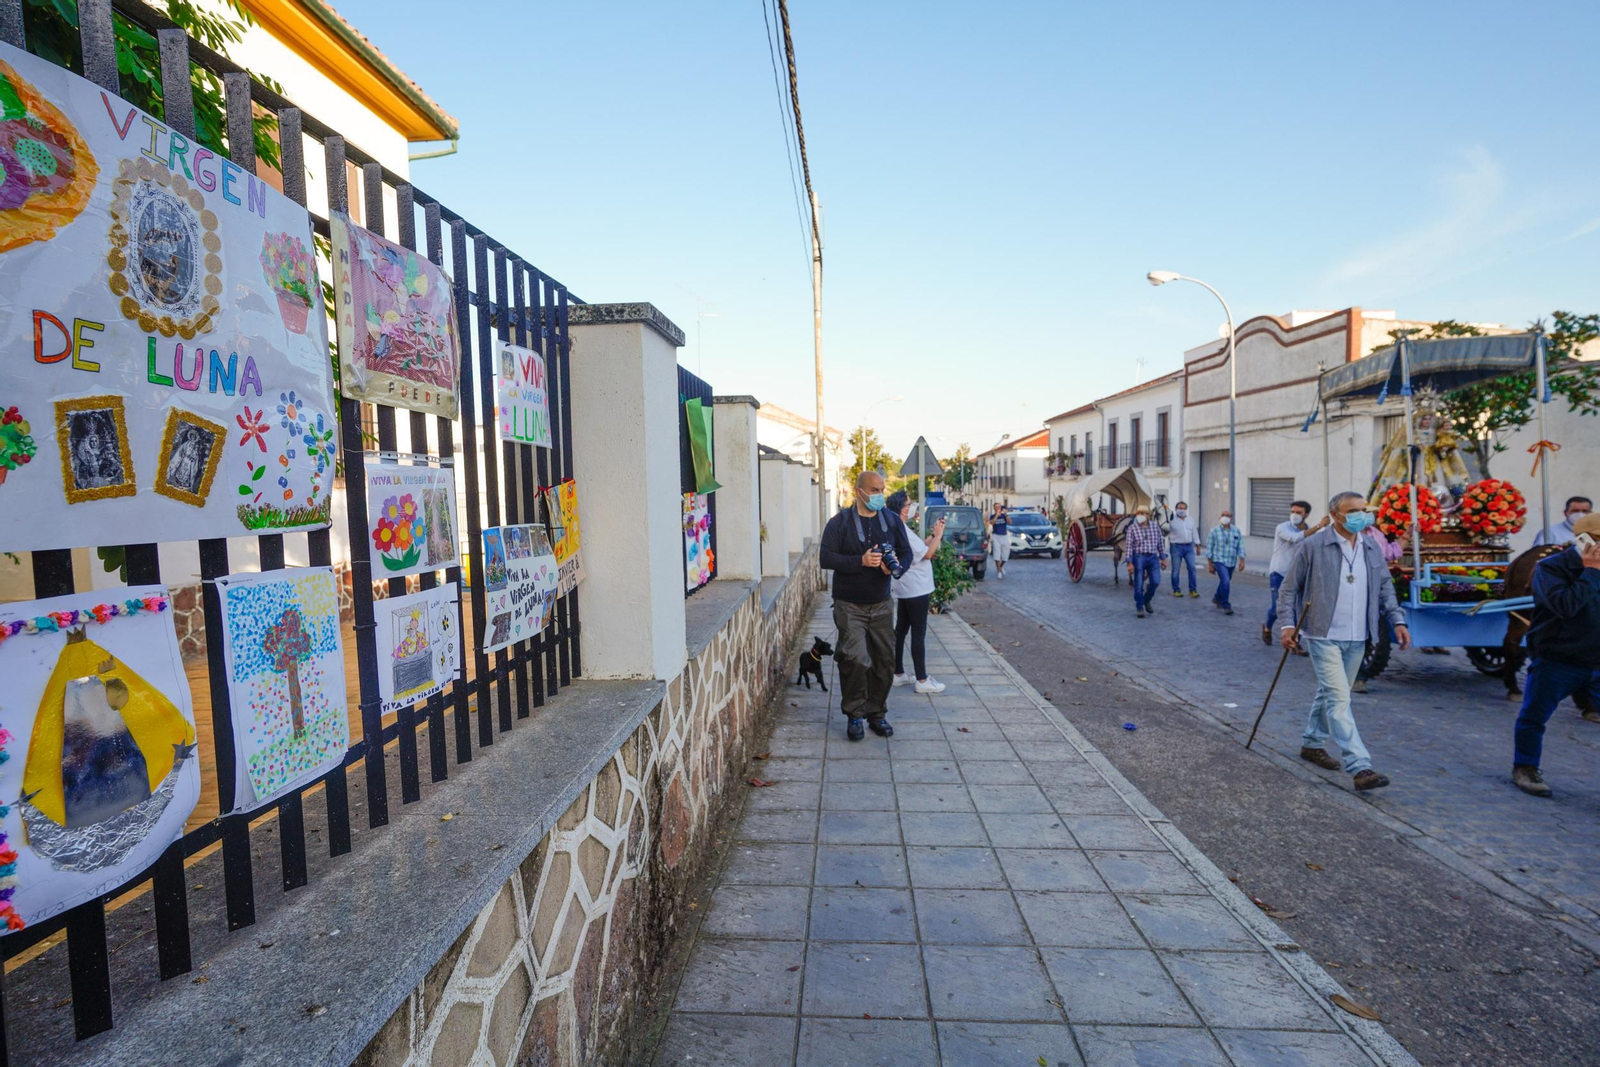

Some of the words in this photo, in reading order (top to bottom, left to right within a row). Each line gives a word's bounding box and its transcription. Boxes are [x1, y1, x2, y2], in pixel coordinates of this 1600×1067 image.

[101, 91, 266, 219] VIRGEN
[340, 248, 352, 327] NADA
[32, 309, 105, 373] DE
[147, 336, 263, 397] LUNA
[388, 381, 441, 405] PUEDE
[509, 388, 518, 398] LA
[393, 475, 402, 485] LA
[561, 574, 577, 595] LUIS
